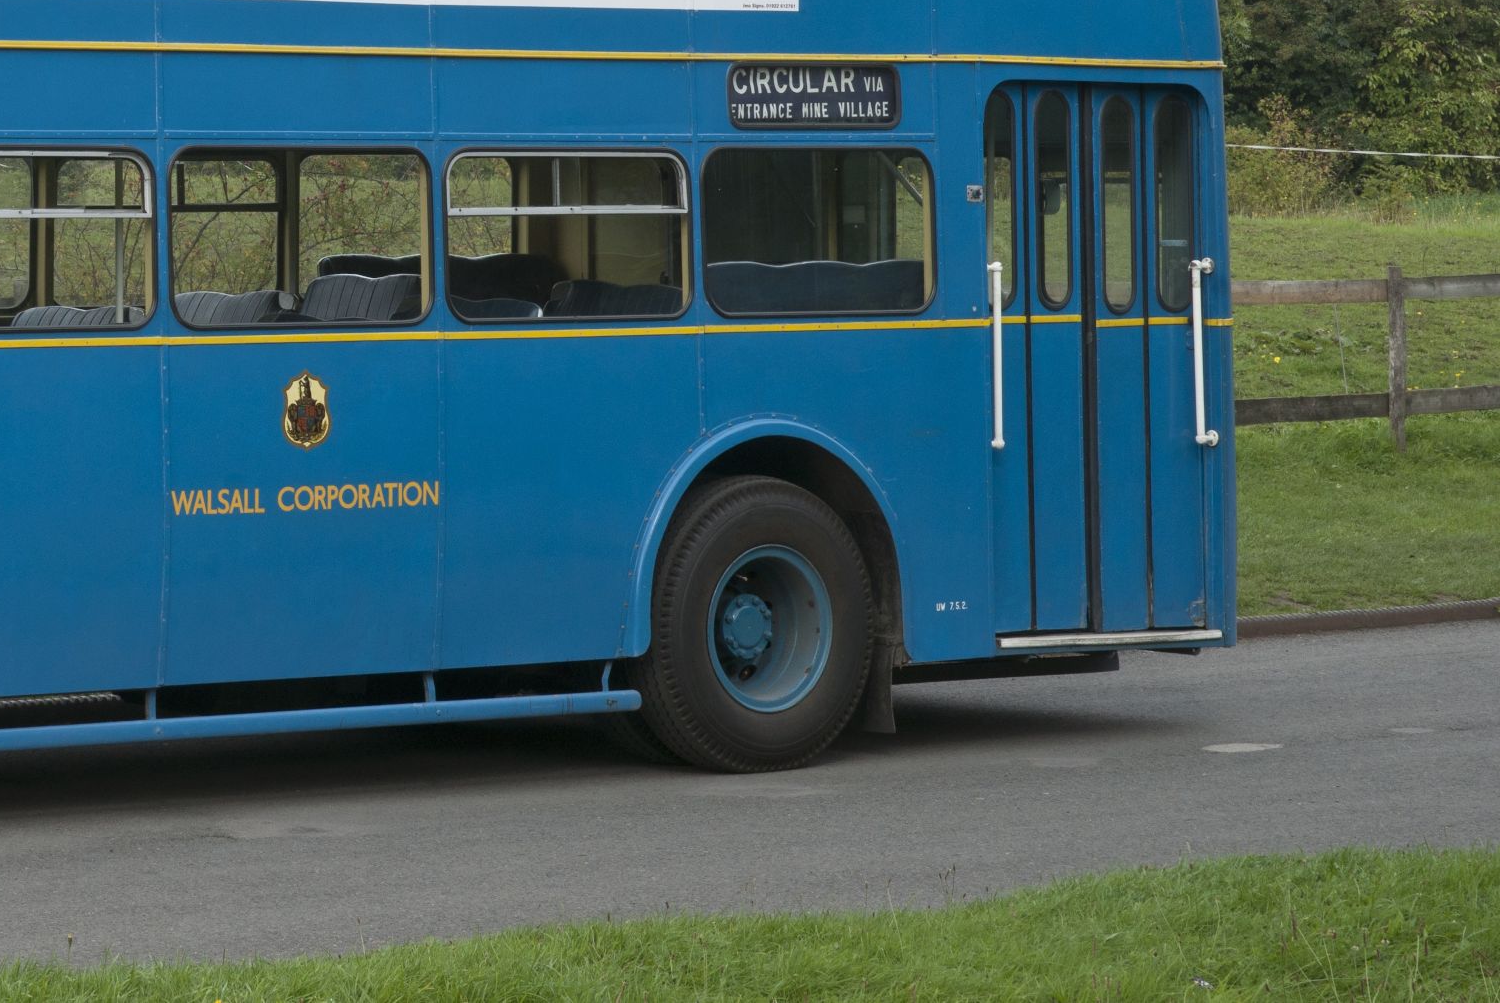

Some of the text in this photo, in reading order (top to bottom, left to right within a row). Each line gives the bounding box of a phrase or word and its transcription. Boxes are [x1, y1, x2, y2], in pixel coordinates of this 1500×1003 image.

[732, 67, 884, 95] CIRCULAR VIA
[802, 102, 829, 118] MINE
[838, 101, 889, 118] VILLAGE
[171, 480, 440, 516] WALSALL CORPORATION
